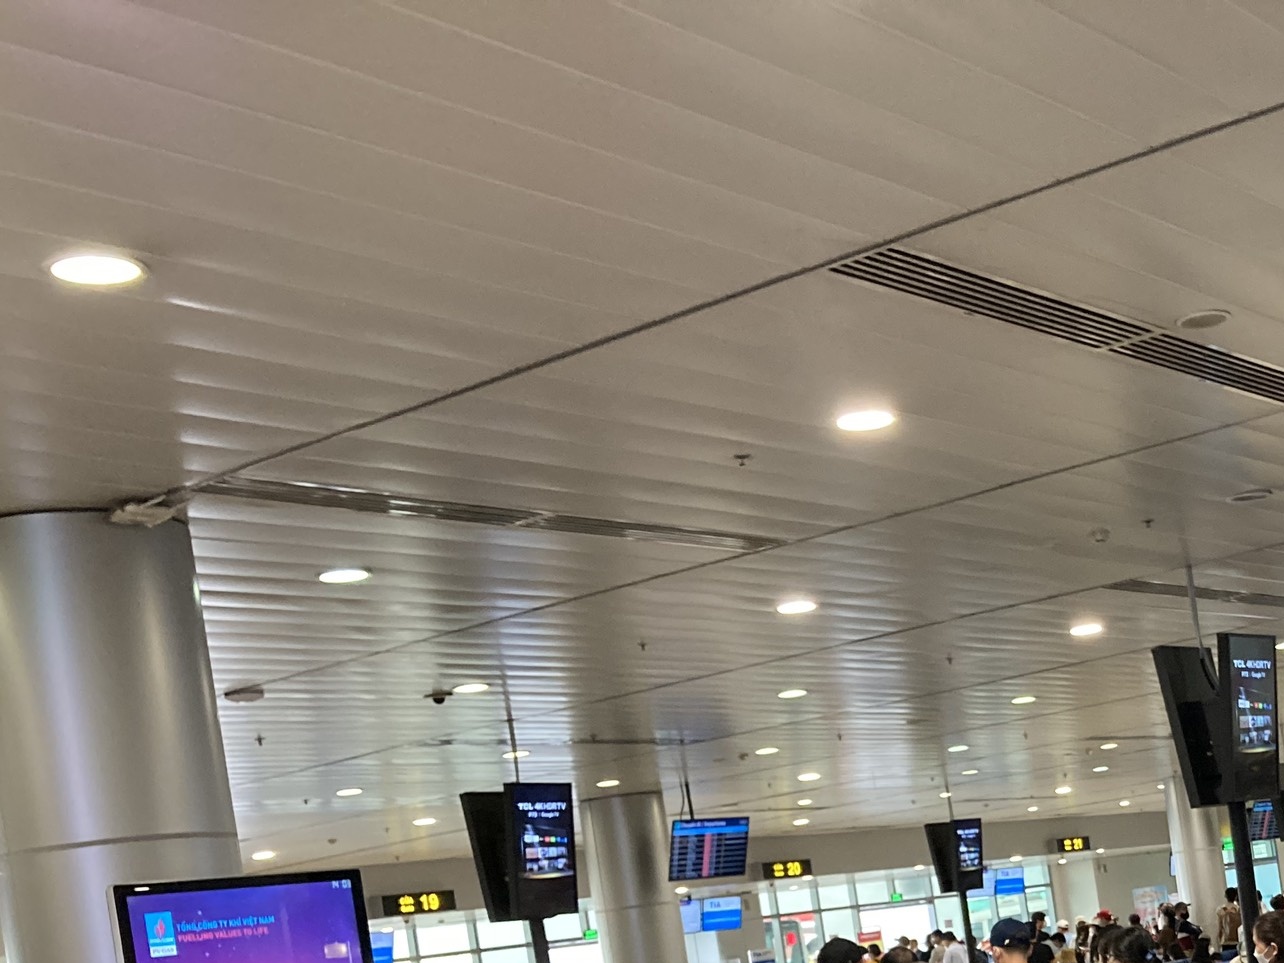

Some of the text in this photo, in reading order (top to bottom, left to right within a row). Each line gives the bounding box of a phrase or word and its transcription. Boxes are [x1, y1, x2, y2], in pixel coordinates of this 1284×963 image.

[1233, 660, 1246, 668] TCL
[517, 802, 534, 811] TCL
[1073, 838, 1083, 850] 21
[786, 862, 801, 876] 20
[420, 893, 440, 911] 19
[219, 919, 228, 929] TY
[228, 917, 241, 927] KHÍ
[242, 915, 258, 928] VIỆT
[258, 915, 275, 924] NAM
[177, 932, 214, 942] FUELLING
[214, 929, 242, 939] VALUES
[243, 928, 252, 936] TO
[253, 926, 269, 936] LIFE
